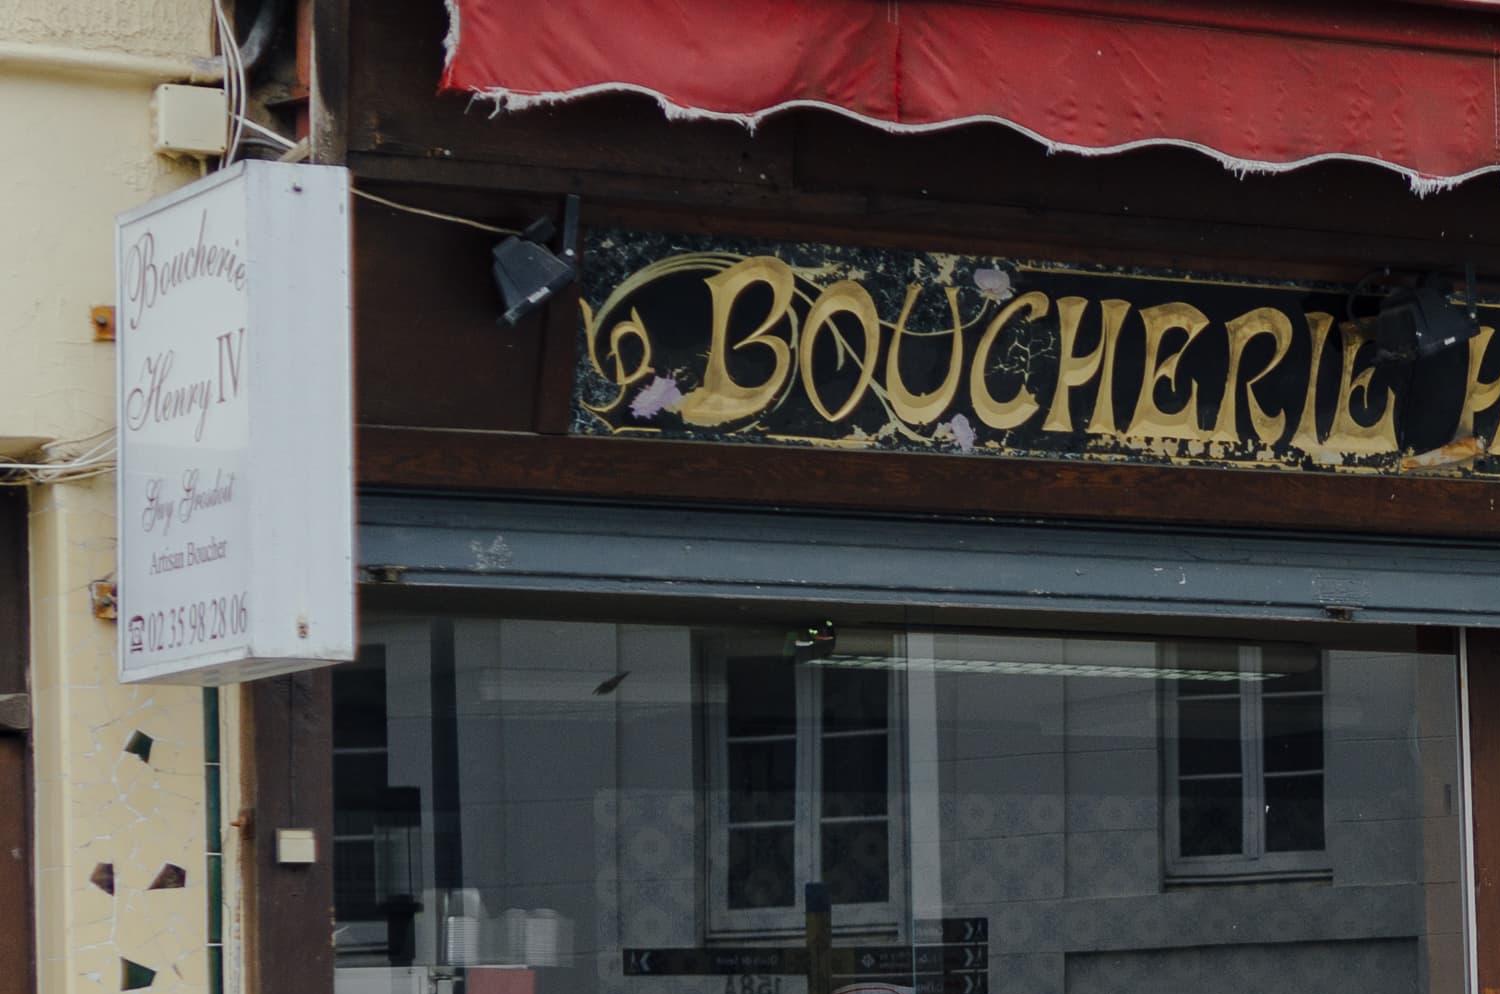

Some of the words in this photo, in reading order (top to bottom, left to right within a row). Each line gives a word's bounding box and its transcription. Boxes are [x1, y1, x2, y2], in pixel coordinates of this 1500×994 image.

[126, 208, 247, 331] Boucherie
[127, 349, 211, 442] Henry
[216, 328, 245, 404] IV
[684, 255, 1399, 457] BOUCHERIE
[142, 479, 175, 537] Guy
[150, 547, 184, 575] Artisan
[187, 536, 228, 567] Boucher
[148, 611, 164, 652] 02
[168, 606, 185, 649] 35
[189, 601, 206, 645] 98
[209, 597, 226, 640] 28
[231, 591, 248, 635] 06
